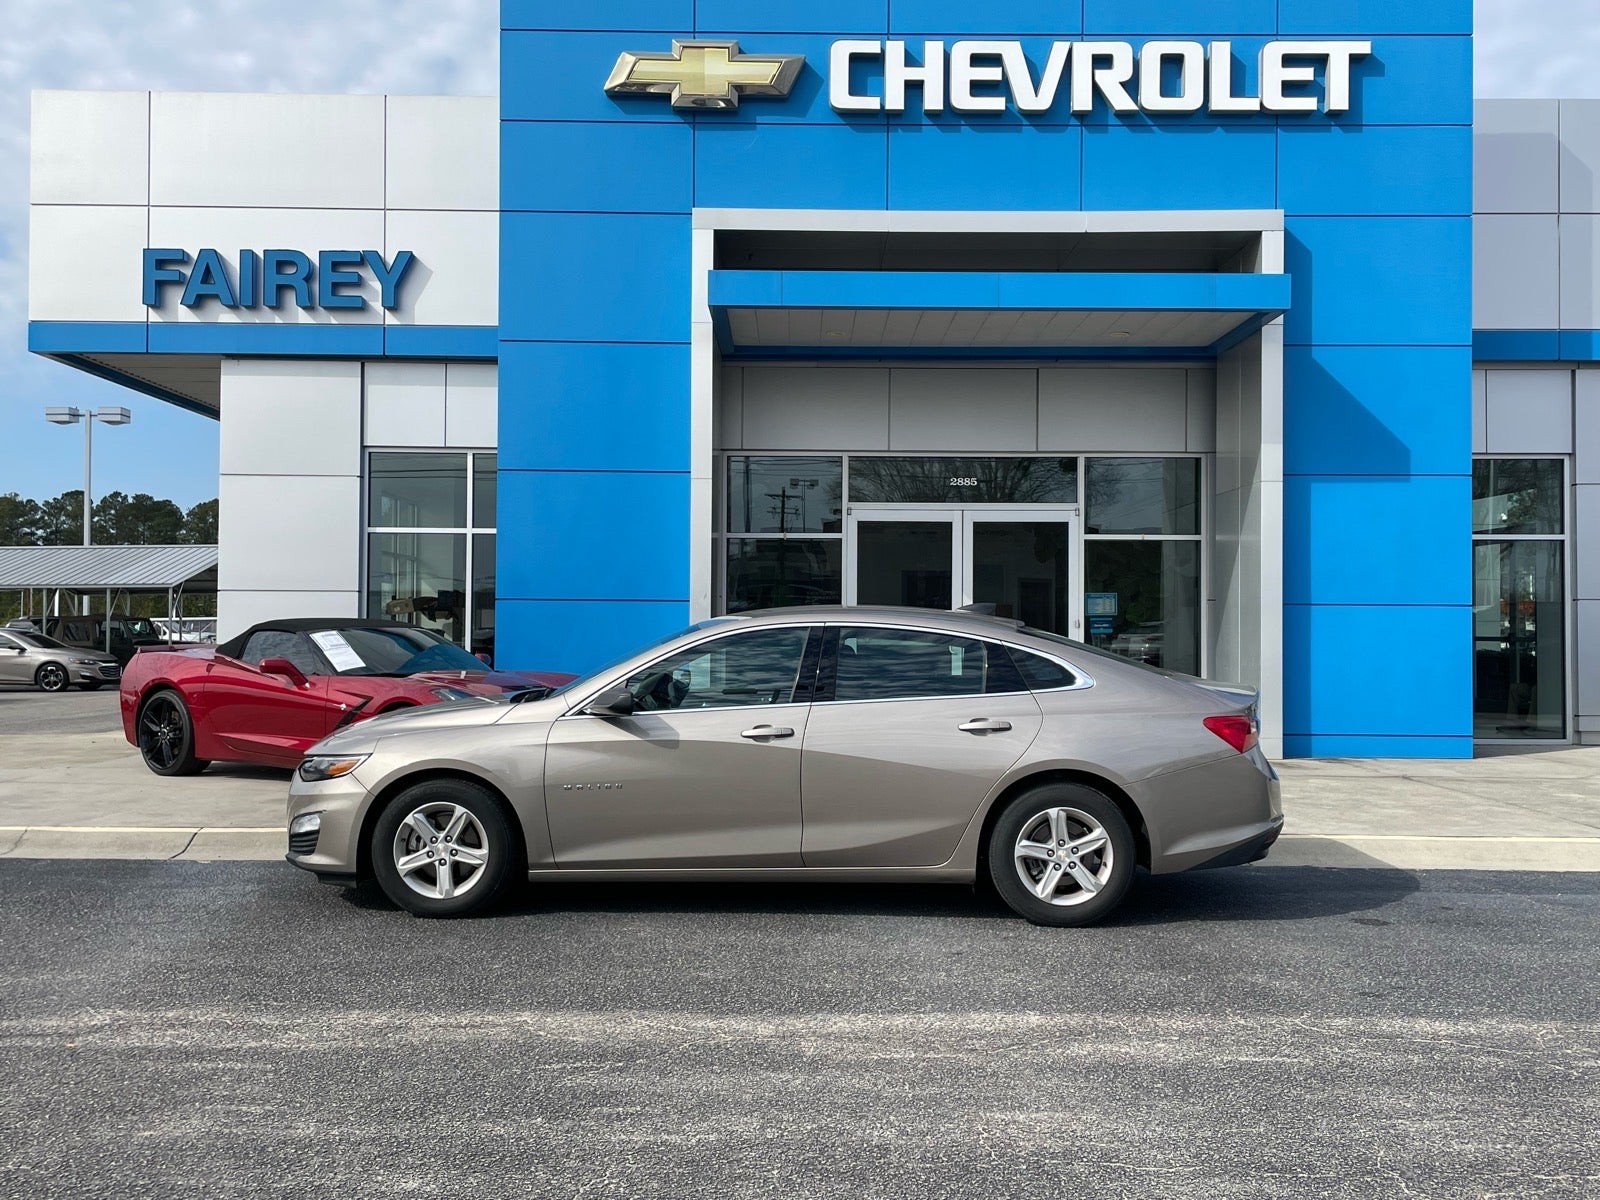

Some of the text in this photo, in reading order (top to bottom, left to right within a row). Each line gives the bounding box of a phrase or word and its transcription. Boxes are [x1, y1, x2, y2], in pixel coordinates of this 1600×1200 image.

[829, 39, 1372, 113] CHEVROLET
[142, 248, 413, 309] FAIREY
[949, 477, 978, 486] 2885
